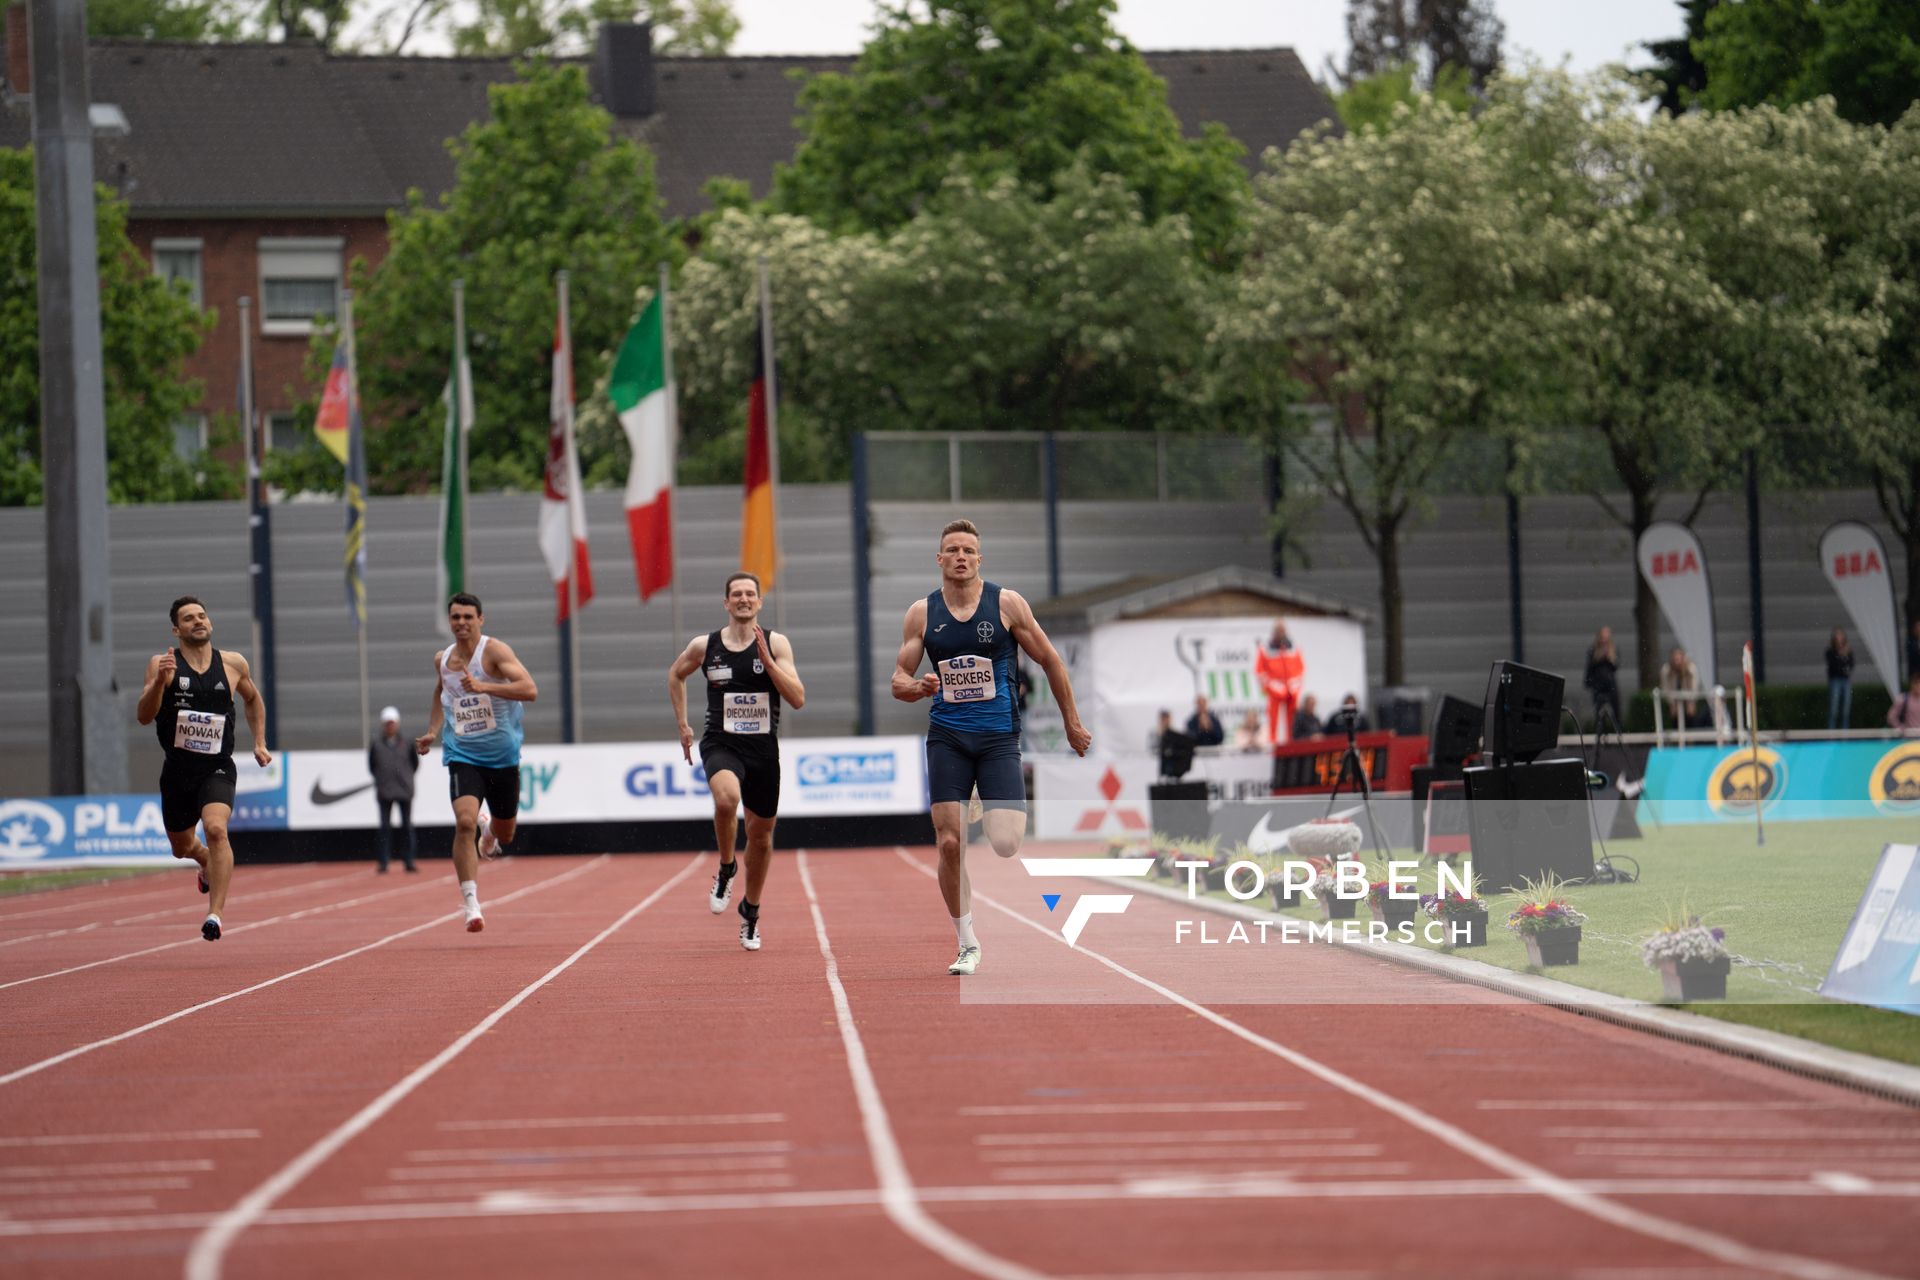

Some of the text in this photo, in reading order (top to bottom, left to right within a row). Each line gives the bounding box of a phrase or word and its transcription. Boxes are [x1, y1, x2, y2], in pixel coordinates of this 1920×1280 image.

[949, 657, 976, 670] GLS
[944, 670, 991, 686] BECKERS
[965, 688, 983, 696] PLAN
[460, 697, 479, 708] GLS
[734, 695, 757, 705] GLS
[188, 713, 211, 725] GLS
[456, 707, 491, 722] BASTIEN
[726, 707, 768, 719] DIECKMANN
[178, 724, 221, 740] NOWAK
[838, 755, 893, 774] PLAN
[624, 763, 711, 797] GLS
[74, 803, 165, 835] PLA
